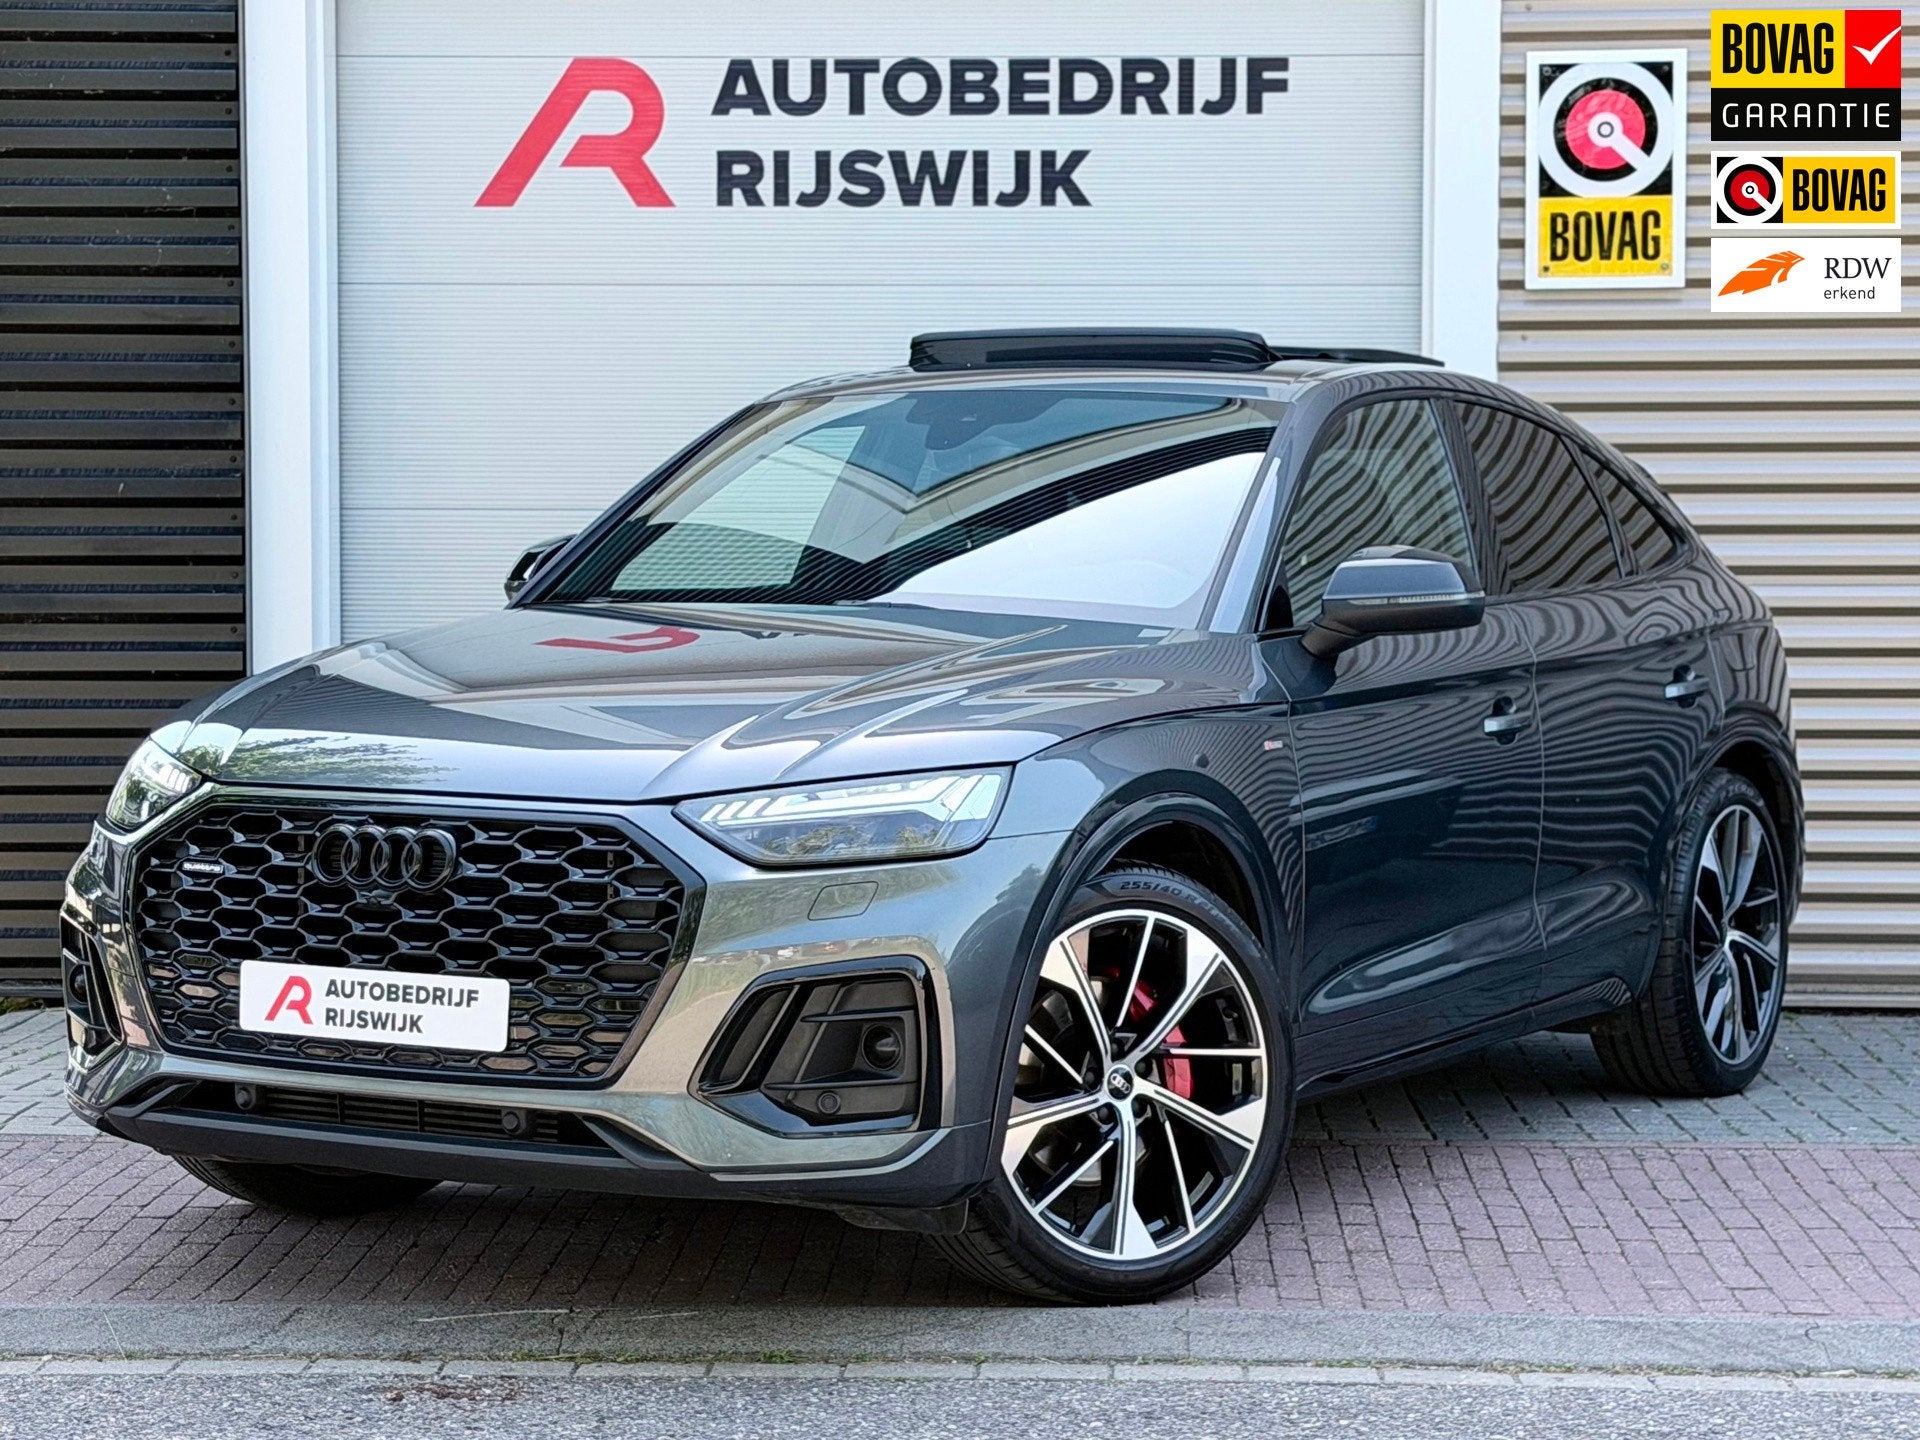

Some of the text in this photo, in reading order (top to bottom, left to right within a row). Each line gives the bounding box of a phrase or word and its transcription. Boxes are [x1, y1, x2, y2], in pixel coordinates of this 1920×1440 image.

[711, 57, 1289, 116] AUTOBEDRIJF
[716, 150, 1092, 208] RIJSWIJK
[1549, 209, 1662, 263] BOVAG
[1121, 880, 1182, 896] 255/40
[325, 978, 479, 1008] AUTOBEDRIJF
[325, 1008, 423, 1034] RIJSWIJK
